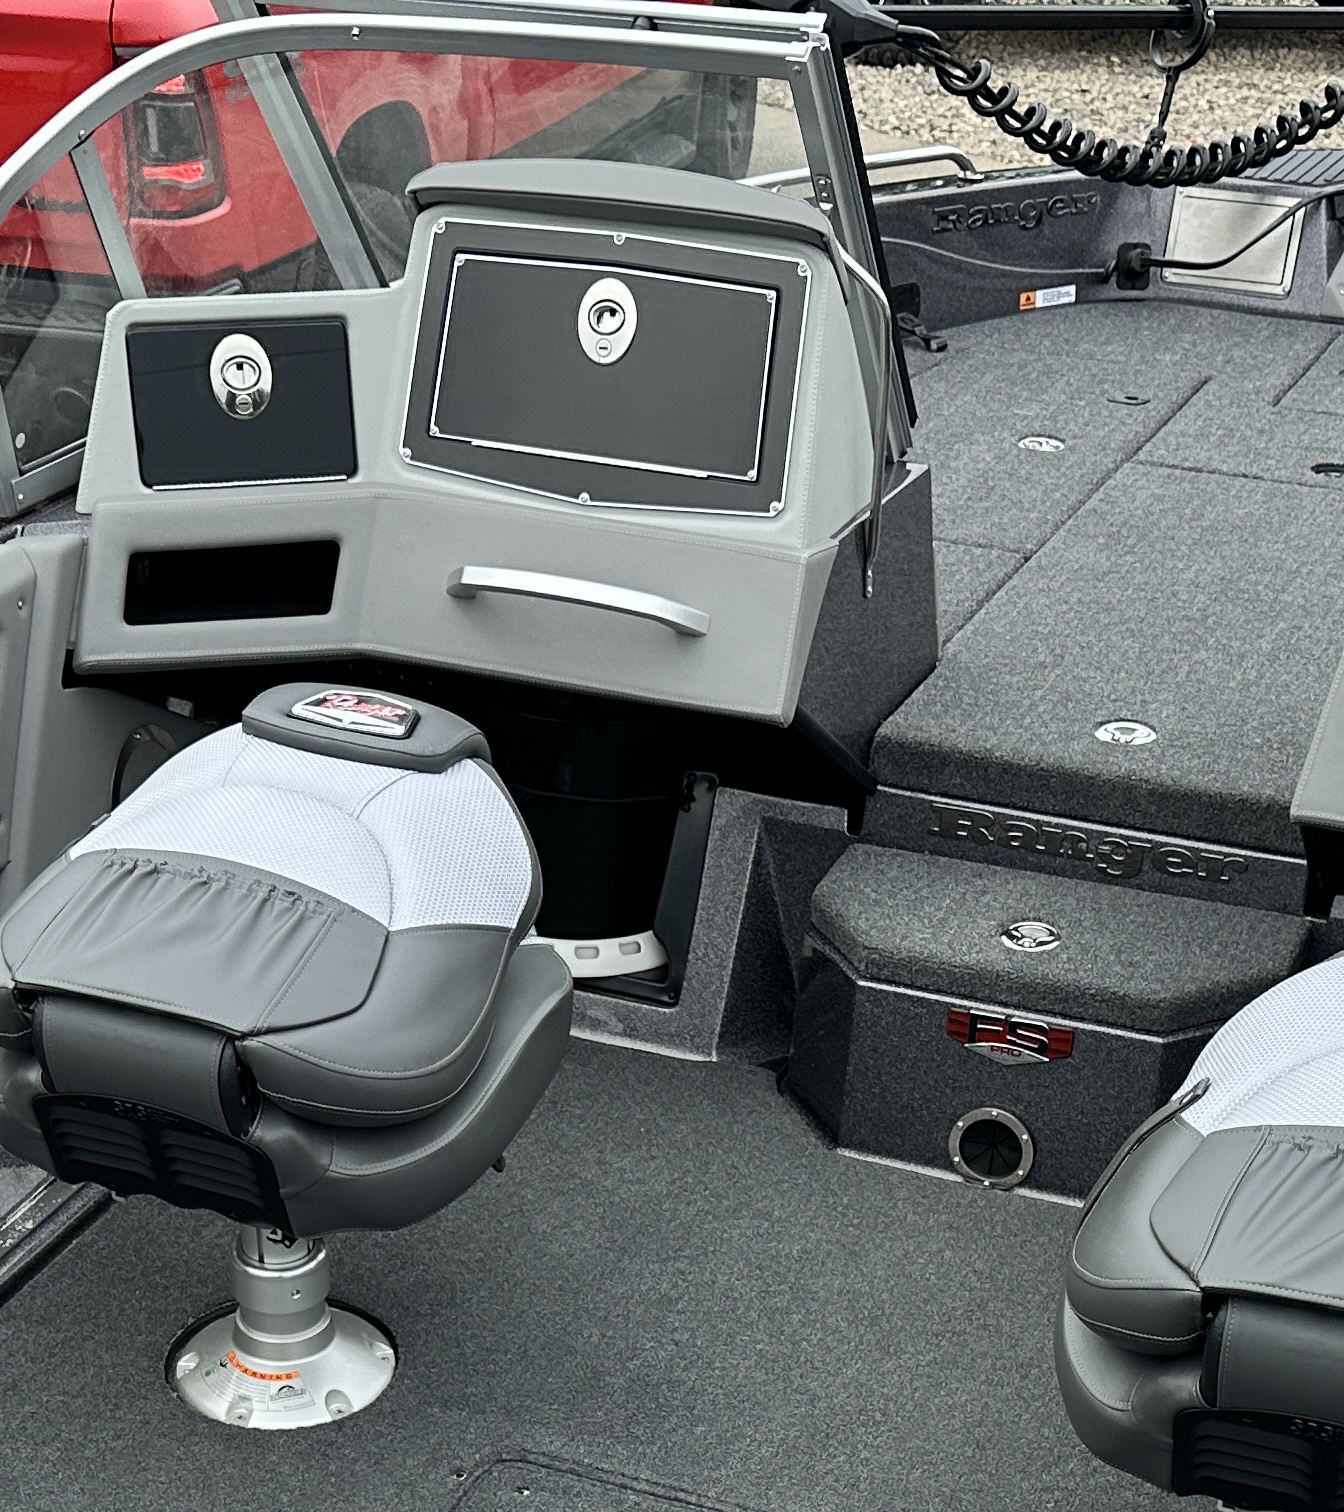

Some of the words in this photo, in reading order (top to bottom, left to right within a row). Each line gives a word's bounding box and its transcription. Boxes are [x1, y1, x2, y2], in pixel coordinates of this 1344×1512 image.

[932, 192, 1100, 235] Ranger
[928, 801, 1249, 881] Ranger
[967, 1009, 1050, 1057] FS
[990, 1045, 1023, 1058] PRO
